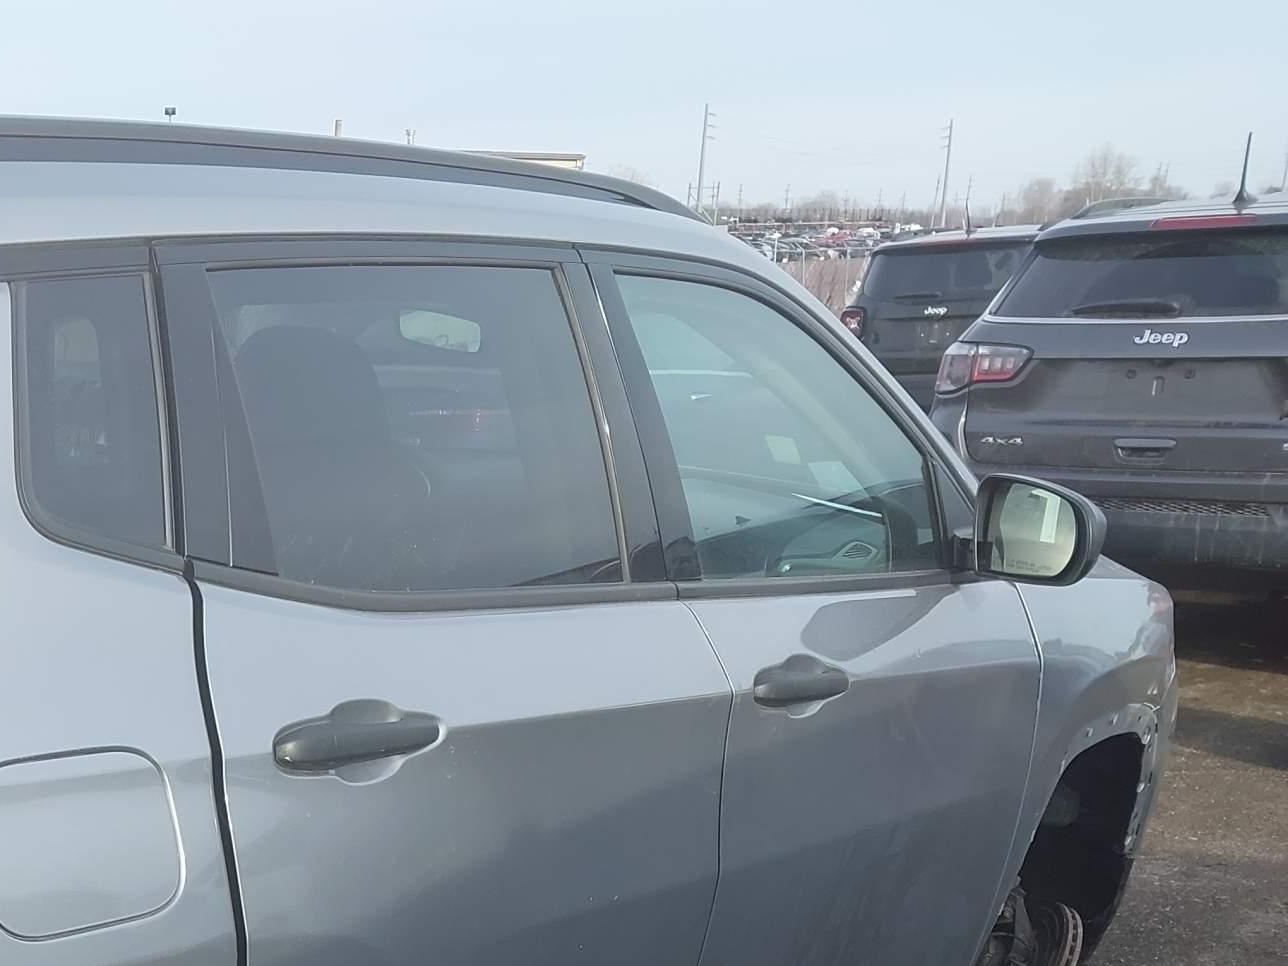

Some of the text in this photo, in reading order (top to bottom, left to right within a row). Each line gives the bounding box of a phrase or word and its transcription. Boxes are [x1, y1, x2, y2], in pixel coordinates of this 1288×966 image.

[923, 304, 949, 317] Jeep
[1133, 328, 1190, 348] Jeep
[979, 435, 1025, 448] 4x4
